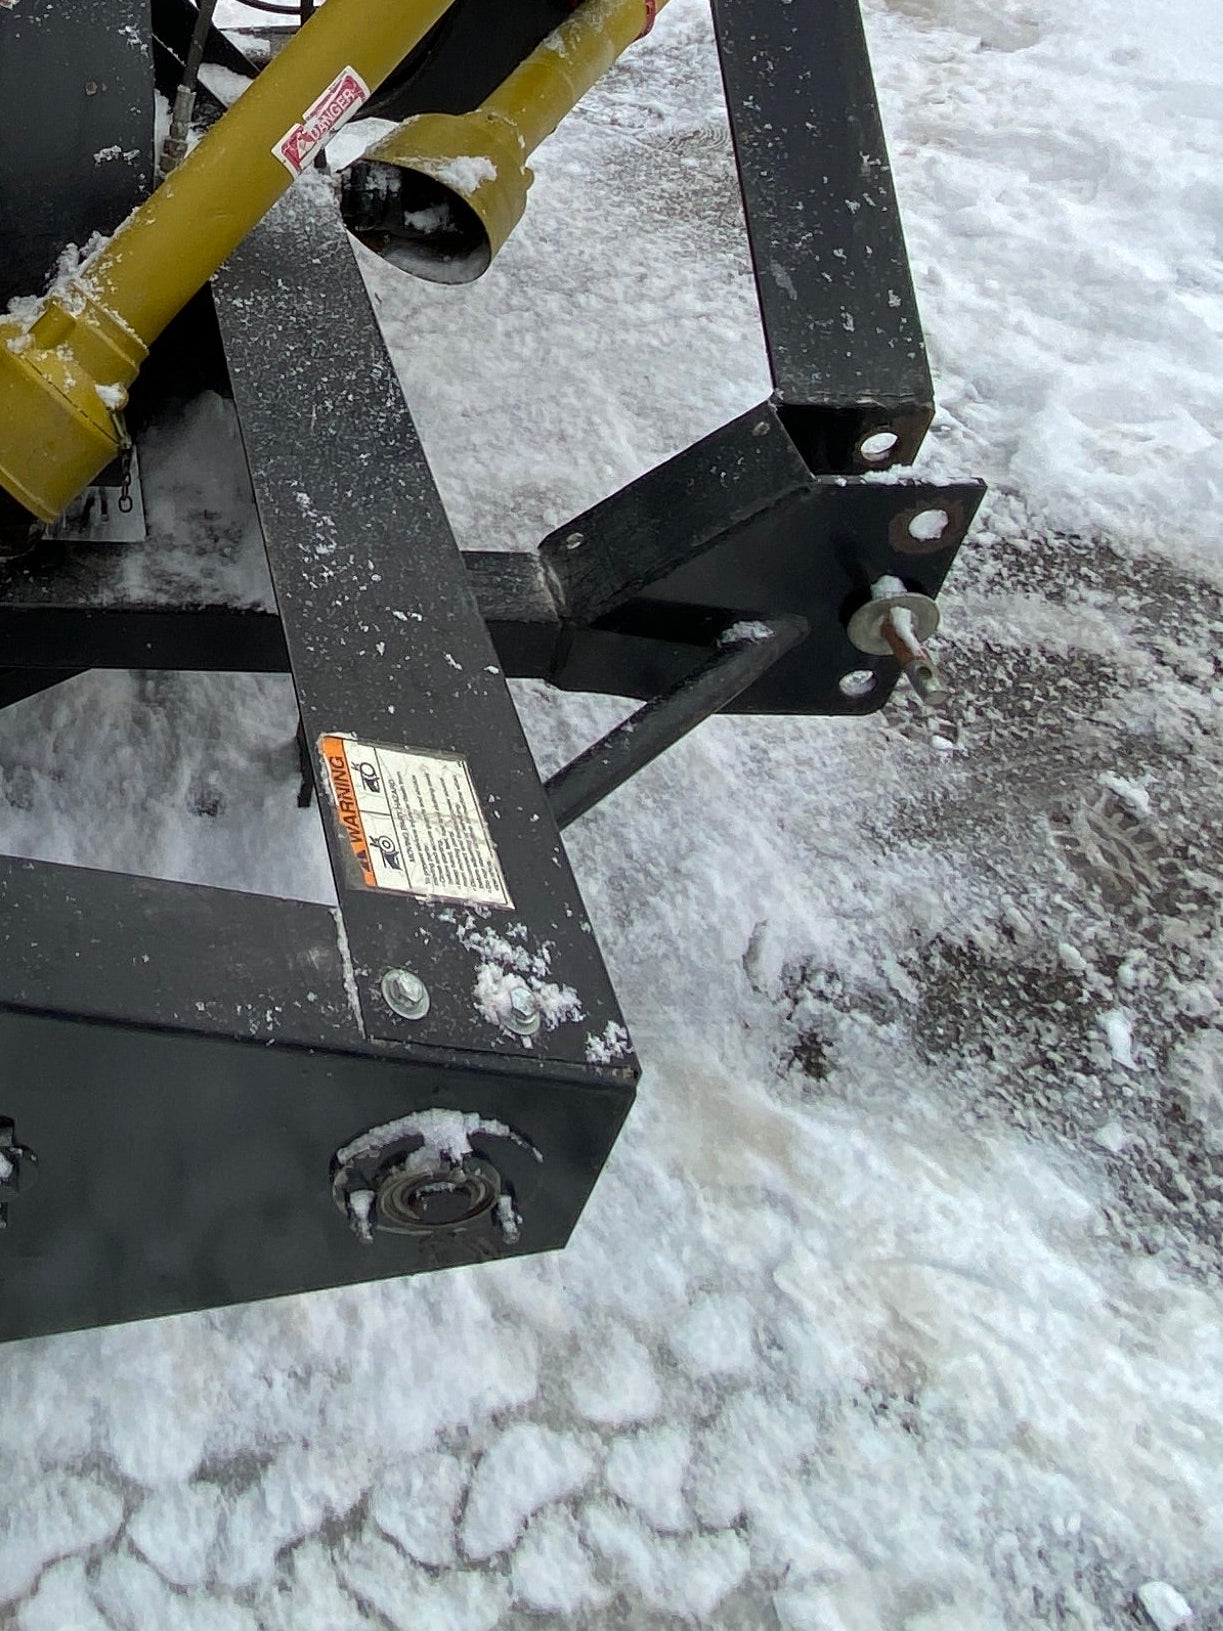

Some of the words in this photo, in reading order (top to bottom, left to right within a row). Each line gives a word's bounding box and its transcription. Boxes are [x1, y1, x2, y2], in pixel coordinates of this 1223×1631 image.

[309, 88, 356, 141] DANGER
[329, 755, 361, 841] WARNING
[388, 779, 401, 809] HAZARD
[429, 788, 439, 811] clothing
[403, 832, 416, 862] MOVING
[455, 848, 465, 871] moving
[430, 863, 440, 886] moving
[475, 869, 483, 888] before
